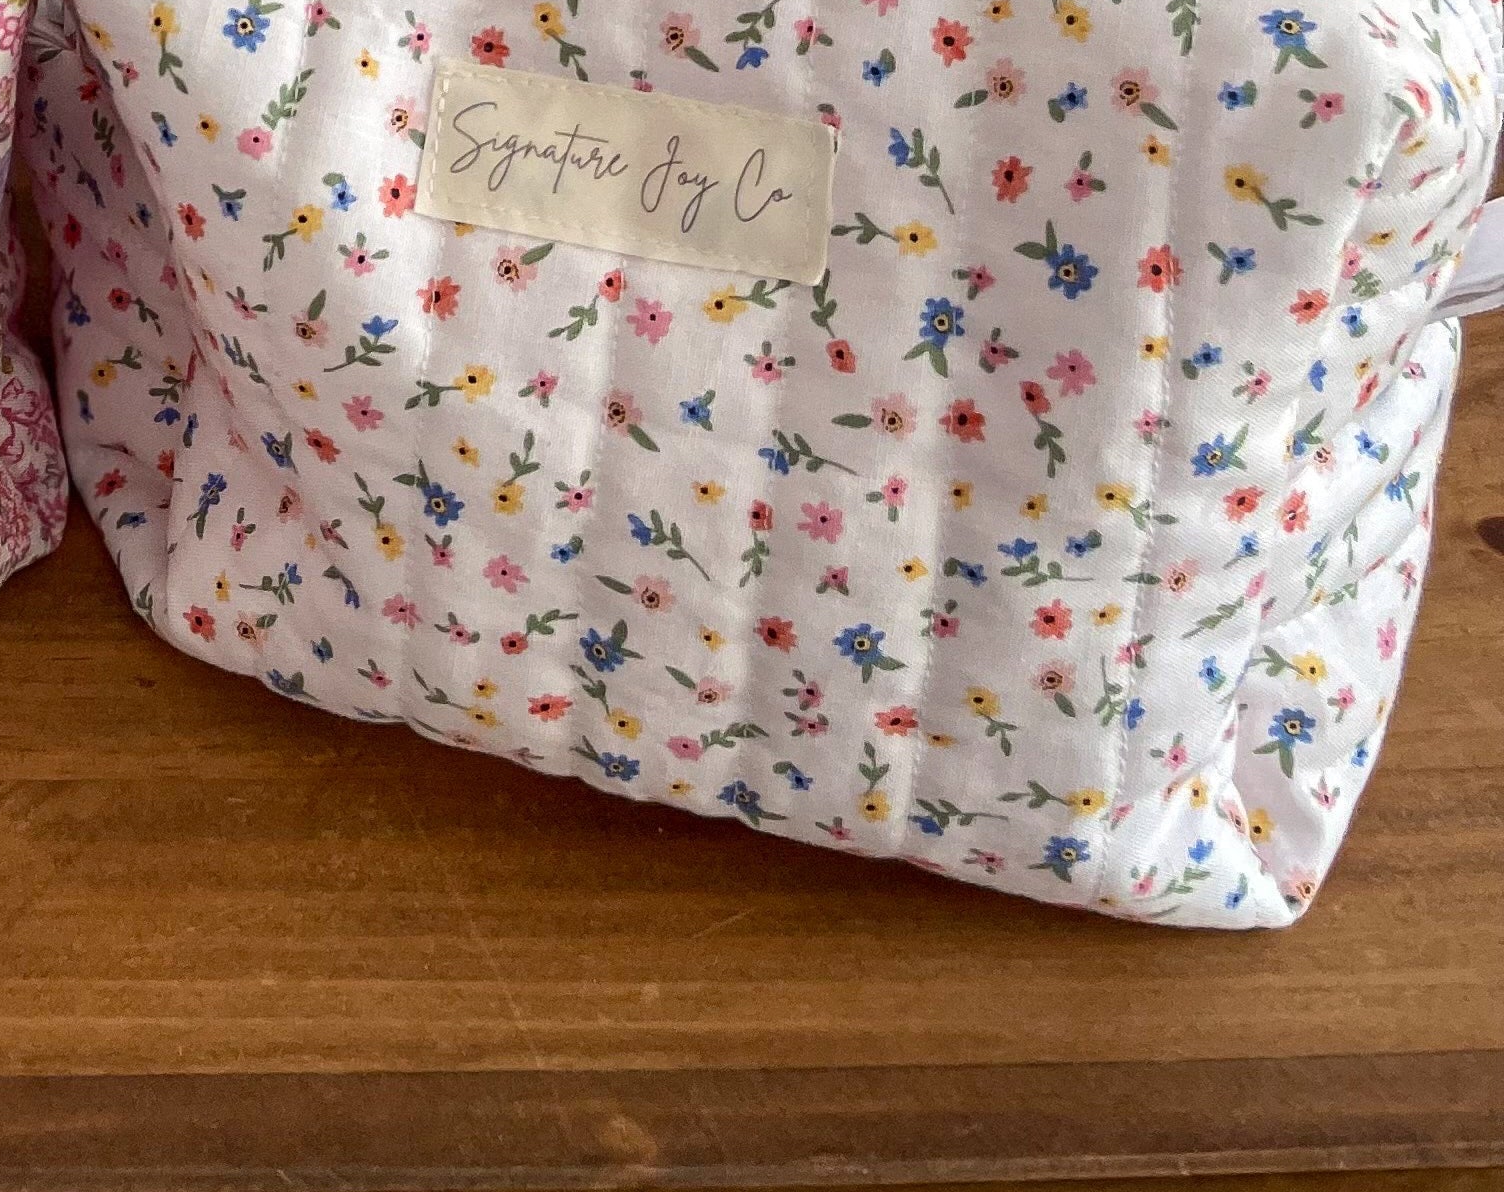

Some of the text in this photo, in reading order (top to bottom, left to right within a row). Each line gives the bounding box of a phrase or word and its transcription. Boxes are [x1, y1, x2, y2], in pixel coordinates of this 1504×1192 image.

[450, 101, 793, 233] Signature Joy Co
